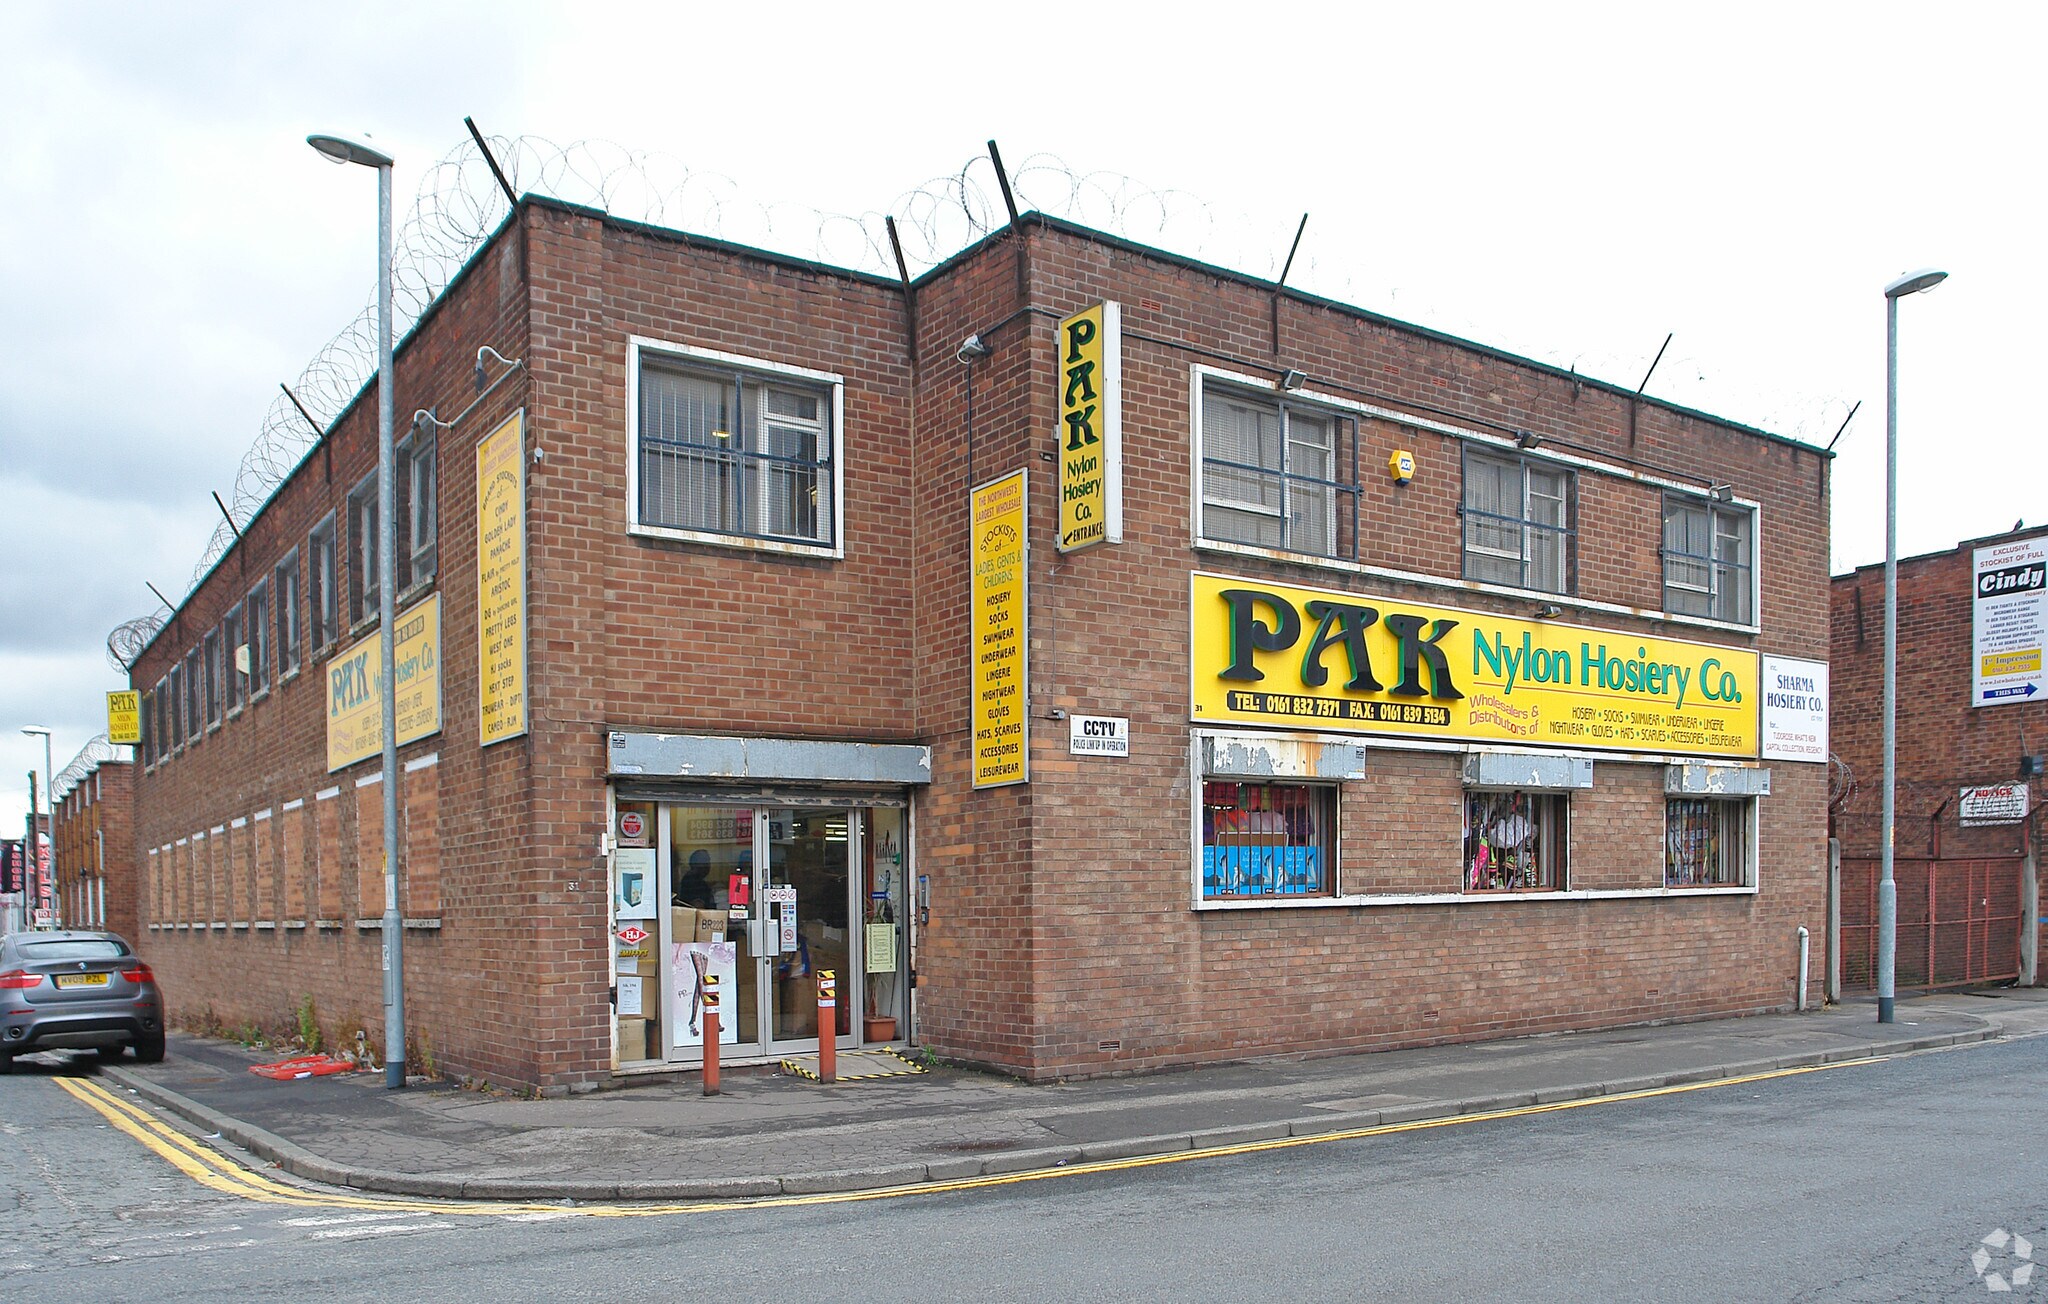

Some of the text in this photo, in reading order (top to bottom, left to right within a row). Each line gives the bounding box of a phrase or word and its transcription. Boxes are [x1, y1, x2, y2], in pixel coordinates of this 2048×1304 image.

[1064, 318, 1100, 452] PAK
[1067, 455, 1097, 481] Nylon
[1063, 477, 1102, 502] Hosiery
[495, 500, 508, 517] CINDY
[978, 493, 987, 507] THE
[975, 505, 995, 523] LARGEST
[1075, 502, 1092, 521] Co.
[484, 514, 516, 544] GOLDEN LADY
[1073, 521, 1103, 542] ENTRANCE
[980, 524, 1018, 553] STOCKISTS
[994, 539, 1003, 553] of
[490, 538, 510, 560] PANACHE
[1993, 544, 2030, 556] EXCLUSIVE
[996, 551, 1016, 569] GENTS
[1980, 556, 2013, 568] STOCKIST
[2027, 551, 2044, 559] FULL
[481, 568, 495, 584] FLAIR
[1980, 567, 2044, 592] Cindy
[986, 590, 1011, 607] HOSIERY
[989, 609, 1009, 625] SOCKS
[2018, 611, 2039, 619] STOCKINGS
[486, 613, 517, 638] PRETTY LEGS
[489, 635, 514, 655] WEST ONE
[983, 627, 1015, 645] SWIMWEAR
[1218, 589, 1465, 701] PAK
[981, 646, 1016, 664] UNDERWEAR
[1996, 653, 2039, 664] Impression
[986, 666, 1011, 682] LINGERIE
[1473, 628, 1742, 710] Nylon Hosiery Co.
[330, 650, 370, 717] PAK
[489, 675, 514, 695] NEXT STEP
[1777, 674, 1814, 692] SHARMA
[982, 684, 1015, 702] NIGHTWEAR
[1767, 692, 1823, 711] HOSIERY CO.
[1994, 688, 2012, 697] THIS
[110, 694, 136, 710] PAK
[1194, 704, 1203, 712] 31
[1234, 693, 1446, 724] TEL: 0161 832 7371 FAX: 0161 839 5134
[1469, 693, 1539, 719] Wholesalers &
[987, 705, 1010, 720] GLOVES
[1572, 706, 1724, 732] HOSIERY SOCKS SWIMWEAR UNDERWEAR LINGERIE
[976, 722, 1021, 741] HATS, SCARVES
[1084, 720, 1116, 736] CCTV
[1469, 710, 1539, 736] Distributors of
[1549, 720, 1742, 747] NIGHTWEAR GLOVES HATS SCARVES ACCESSORIES LEISUREWEAR
[980, 742, 1019, 759] ACCESSORIES
[979, 762, 1019, 778] LEISUREWEAR
[39, 910, 48, 918] TO
[701, 919, 724, 930] BR223
[625, 931, 640, 939] HJ
[86, 974, 103, 983] PZL
